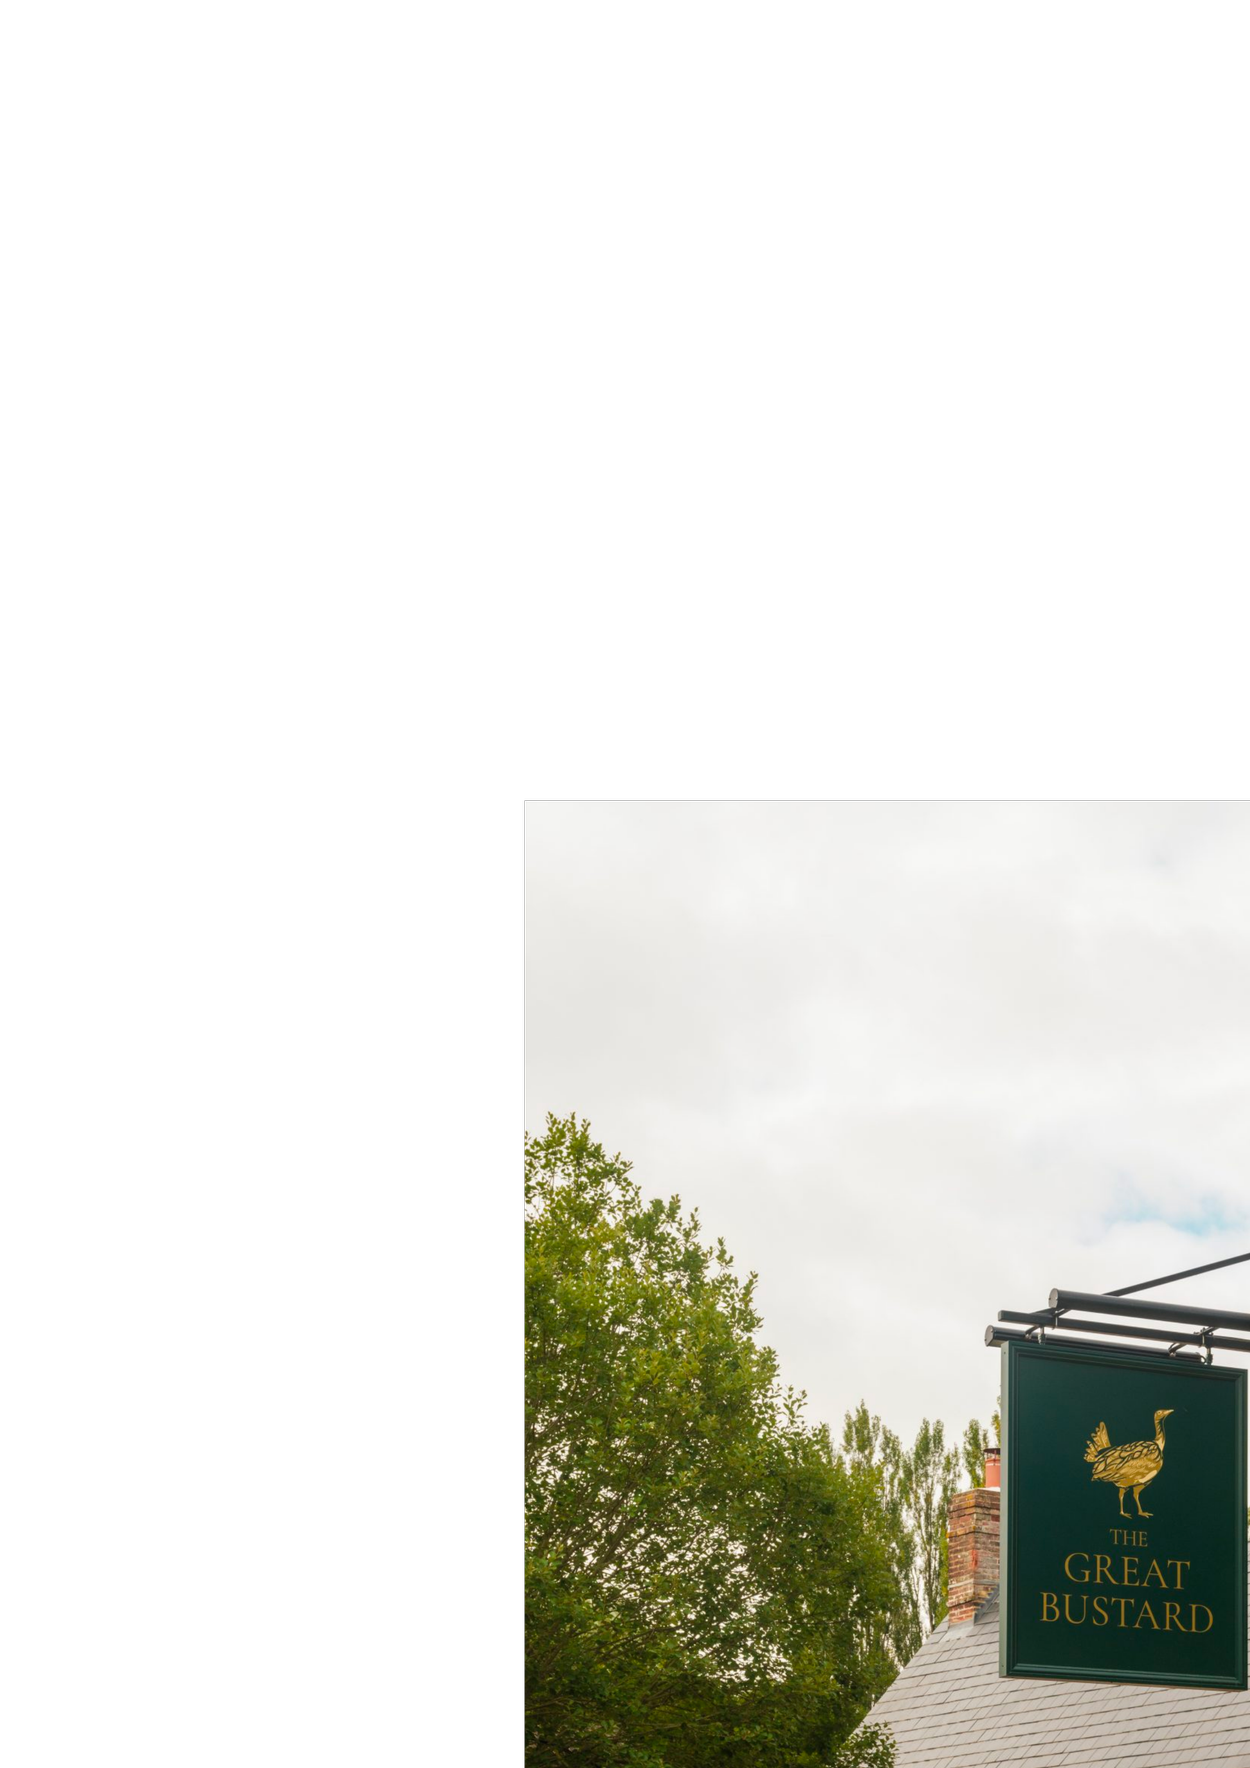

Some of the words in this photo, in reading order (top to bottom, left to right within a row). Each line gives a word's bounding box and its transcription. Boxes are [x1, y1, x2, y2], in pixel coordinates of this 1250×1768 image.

[1109, 1528, 1149, 1548] THE
[1064, 1552, 1191, 1590] GREAT
[1039, 1592, 1214, 1634] BUSTARD
